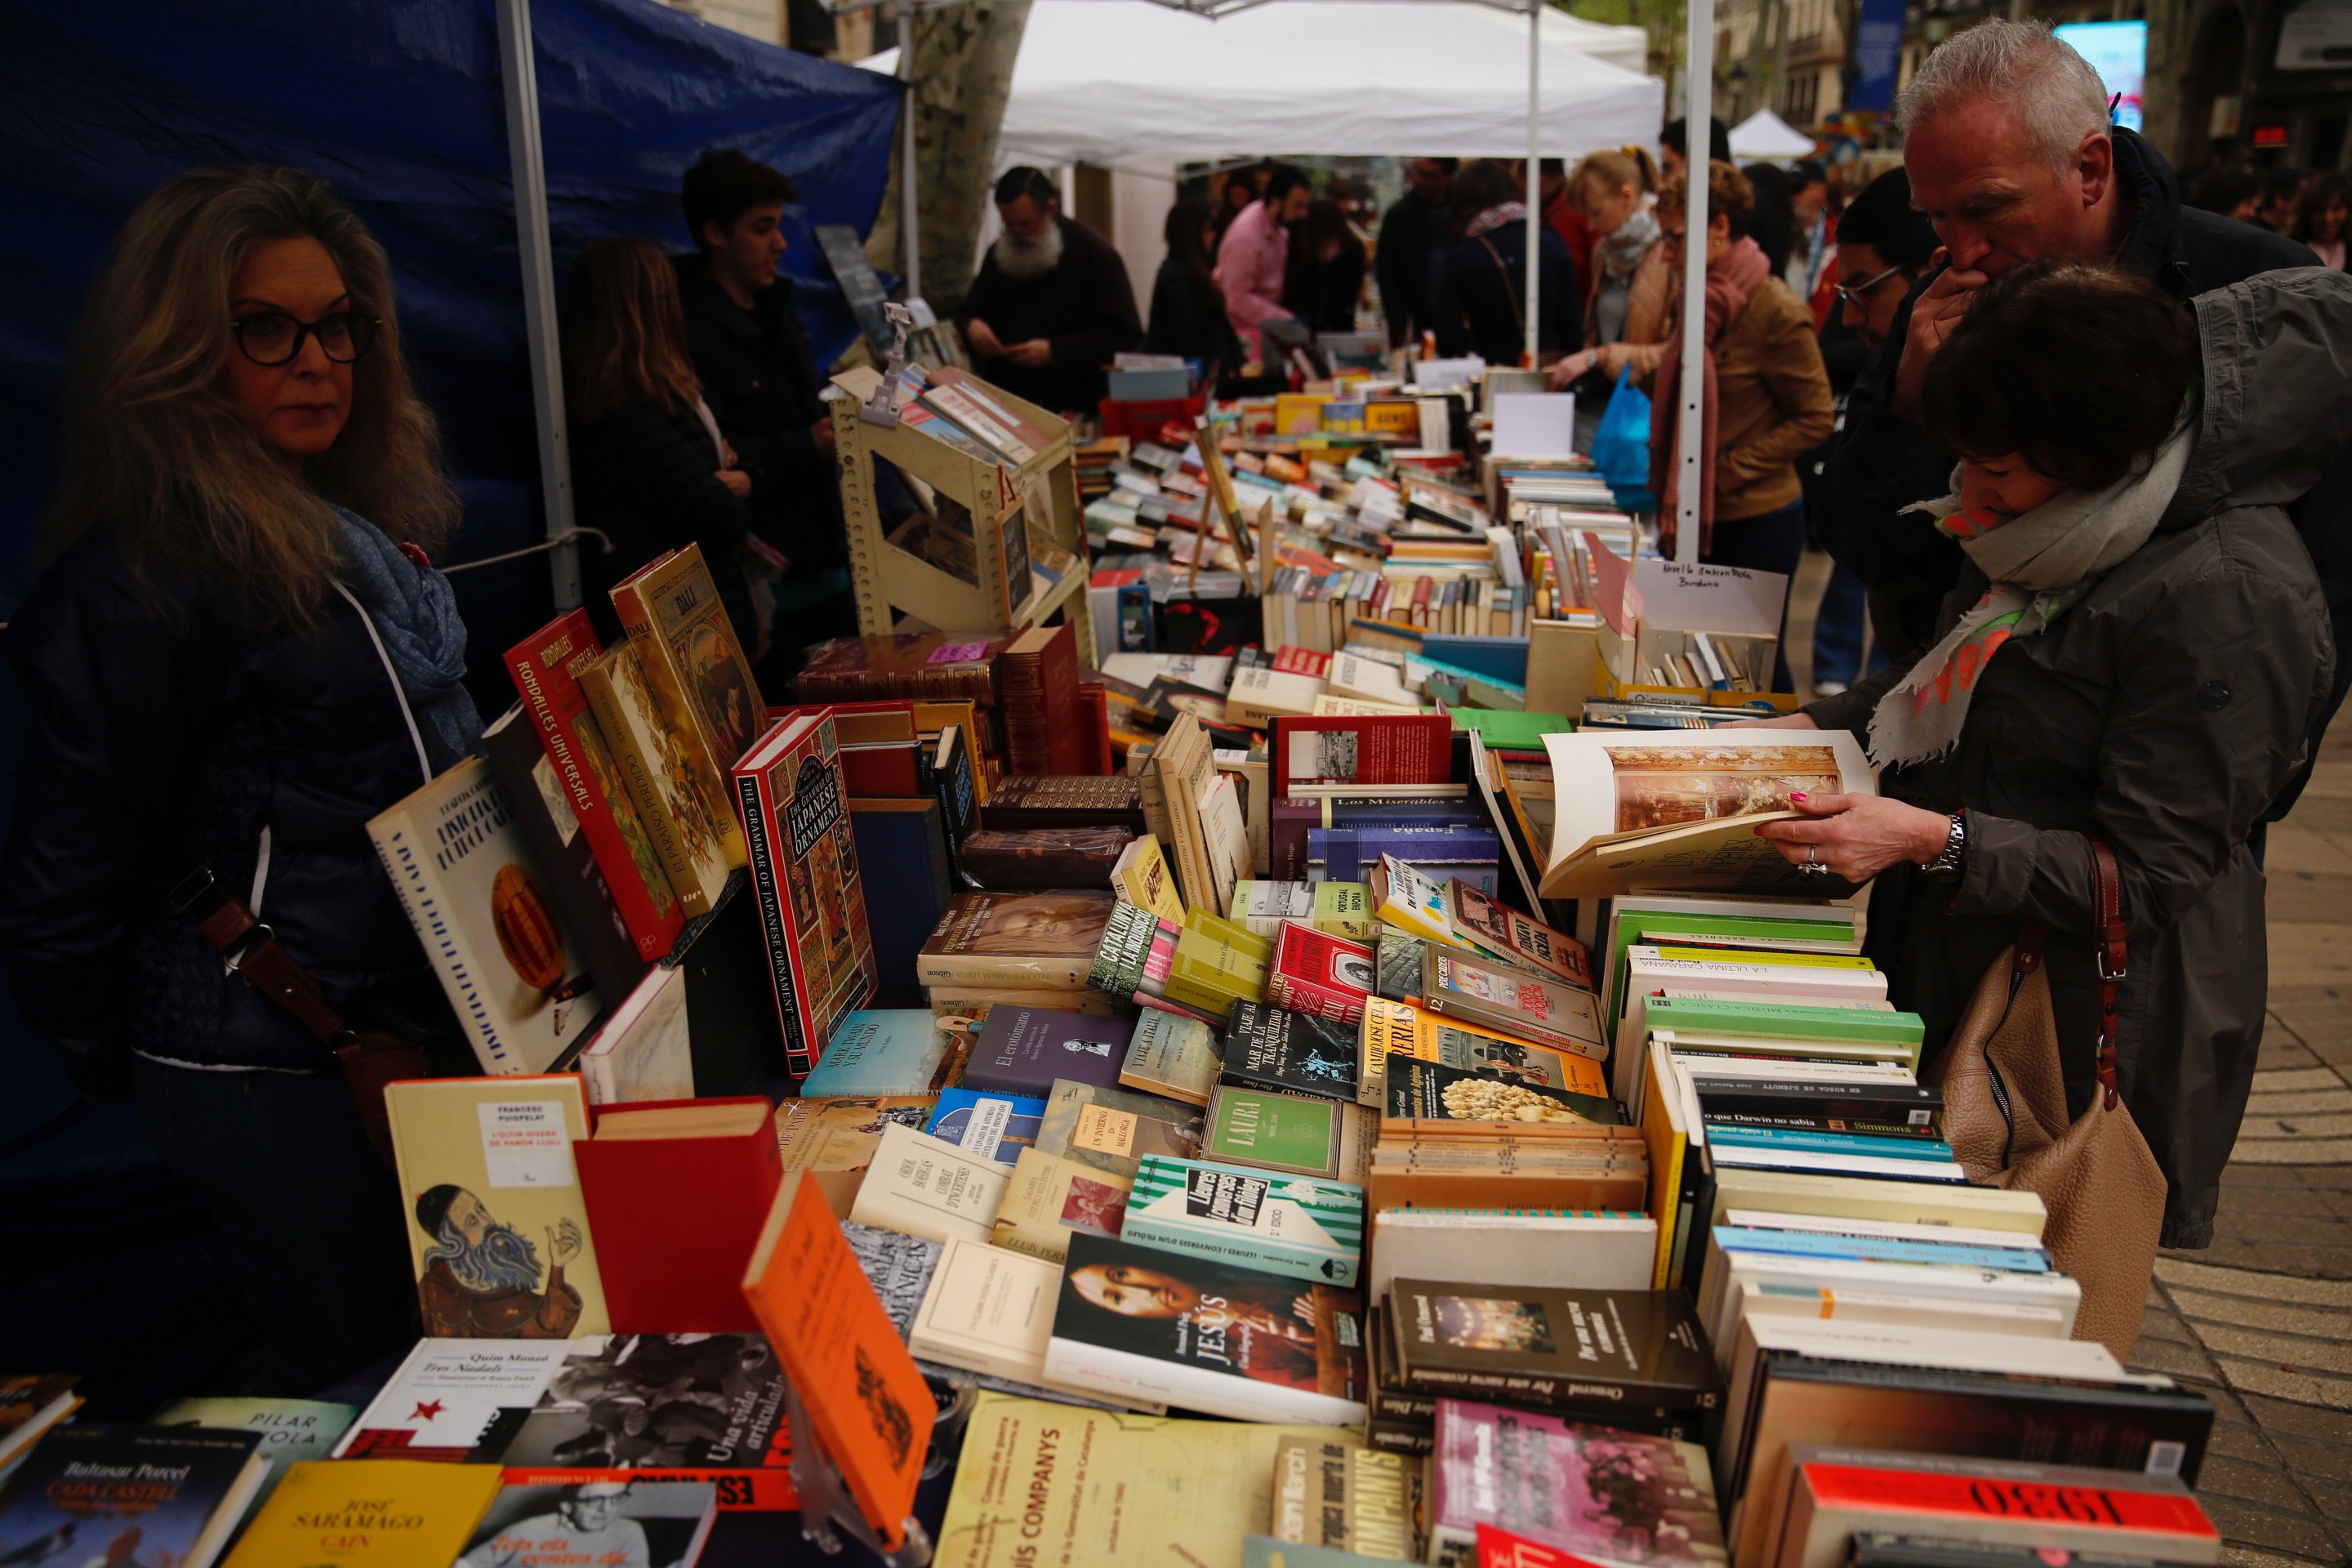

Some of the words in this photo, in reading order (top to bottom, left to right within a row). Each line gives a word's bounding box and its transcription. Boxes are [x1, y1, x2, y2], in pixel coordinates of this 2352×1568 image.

[675, 586, 697, 616] DALI
[628, 622, 650, 638] DALI
[540, 632, 572, 670] RONDALLES
[568, 644, 599, 680] UNIVERSALS
[518, 661, 557, 731] RONDALLES
[550, 733, 593, 810] UNIVERSALS
[612, 723, 630, 745] JOHN
[625, 755, 654, 808] PERDIDO
[743, 780, 755, 797] THE
[790, 804, 802, 819] THE
[801, 782, 823, 811] GRAMMAR
[824, 772, 833, 784] OF
[1337, 798, 1364, 807] Los
[1369, 797, 1445, 806] Miserables
[791, 786, 836, 840] JAPANESE
[1173, 801, 1183, 837] CABALLERESCO
[748, 808, 765, 868] GRAMMAR
[795, 804, 840, 858] ORNAMENT
[672, 860, 686, 875] EL
[760, 871, 768, 888] OF
[1338, 889, 1348, 913] PORTUGAL
[1352, 893, 1361, 911] ENFORA
[1407, 899, 1417, 909] DE
[763, 891, 781, 947] JAPANESE
[933, 926, 944, 938] Ian
[940, 909, 958, 930] Gibson
[1099, 900, 1136, 964] CATALUNYA
[1493, 944, 1517, 960] ISOLDA
[1534, 930, 1553, 963] ISOLDA
[1123, 948, 1138, 967] LA
[1439, 956, 1448, 973] CALDERS
[1642, 960, 1702, 971] CARAVANA
[1707, 963, 1747, 973] ÚLTIMA
[1752, 965, 1767, 973] LA
[774, 950, 794, 1013] ORNAMENT
[1438, 973, 1448, 989] PERE
[1521, 985, 1532, 994] SE
[1373, 1001, 1385, 1022] CELA
[1429, 999, 1443, 1012] 12
[1521, 995, 1532, 1012] TODO
[1533, 983, 1548, 1020] APROVECHA
[1239, 1013, 1254, 1034] VIAJE
[1248, 1003, 1256, 1013] AL
[850, 1049, 862, 1059] SU
[856, 1023, 880, 1050] MUNDO
[996, 1054, 1011, 1067] El
[1004, 1012, 1031, 1056] erotómano
[1257, 1026, 1266, 1036] LA
[1263, 1009, 1282, 1065] TRANQUILIDAD
[1372, 1023, 1383, 1045] JOSÉ
[827, 1046, 849, 1068] MARK
[845, 1022, 866, 1047] TWAIN
[1025, 1040, 1033, 1049] vida
[1251, 1037, 1262, 1051] DE
[1031, 1050, 1039, 1061] Henry
[1133, 1045, 1149, 1067] VIAJE
[1247, 1052, 1259, 1071] MAR
[1370, 1046, 1384, 1075] CAMILO
[1410, 1065, 1423, 1088] Agripina
[499, 1114, 545, 1122] PUIGPELAT
[787, 1105, 814, 1135] PAPEL
[991, 1104, 1007, 1127] PRINCIPADO
[1094, 1111, 1108, 1137] INVIERNO
[1227, 1102, 1260, 1146] LAURA
[1714, 1115, 1731, 1125] que
[1734, 1114, 1771, 1125] Darwin
[1788, 1116, 1816, 1128] sabía
[973, 1131, 987, 1147] LINAJES
[981, 1106, 995, 1125] ASTURIAS
[1116, 1118, 1129, 1147] MALLORCA
[1854, 1121, 1912, 1134] Simmons
[1093, 1137, 1101, 1147] UN
[913, 1159, 933, 1188] BOHIGAS
[1022, 1176, 1038, 1201] SAGARRA
[1187, 1171, 1218, 1205] Lleures
[1214, 1174, 1237, 1214] converses
[1158, 1236, 1178, 1245] D'UN
[1178, 1239, 1223, 1254] CONVERSES
[1228, 1248, 1258, 1258] LLEURES
[1178, 1311, 1192, 1331] Puig
[1196, 1294, 1231, 1366] JESÚS
[1572, 1326, 1591, 1343] una
[470, 1353, 504, 1363] Quim
[506, 1353, 550, 1362] Monzó
[1575, 1343, 1597, 1361] Por
[423, 1363, 451, 1372] Tres
[452, 1363, 501, 1373] Nadals
[1471, 1374, 1503, 1387] nueva
[1507, 1378, 1526, 1388] una
[1530, 1379, 1554, 1394] Por
[1568, 1383, 1623, 1399] Ormerod
[1383, 1399, 1411, 1413] Dios
[249, 1412, 317, 1428] PILAR
[706, 1428, 742, 1462] Una
[730, 1391, 760, 1425] vida
[996, 1417, 1009, 1447] guerra
[1078, 1420, 1094, 1467] Catalunya
[992, 1450, 1001, 1463] de
[65, 1462, 132, 1479] Baltasar
[136, 1463, 191, 1481] Porcel
[1073, 1471, 1085, 1481] de
[44, 1481, 97, 1498] CADA
[982, 1470, 997, 1503] Consejo
[1022, 1428, 1060, 1539] COMPANYS
[1319, 1462, 1344, 1503] muerte
[1064, 1484, 1082, 1539] Generalitat
[1970, 1481, 2125, 1526] 1930
[292, 1512, 425, 1530] SARAMAGO
[492, 1537, 535, 1552] Tots
[539, 1539, 568, 1552] els
[1062, 1540, 1073, 1550] la
[1062, 1553, 1071, 1565] de
